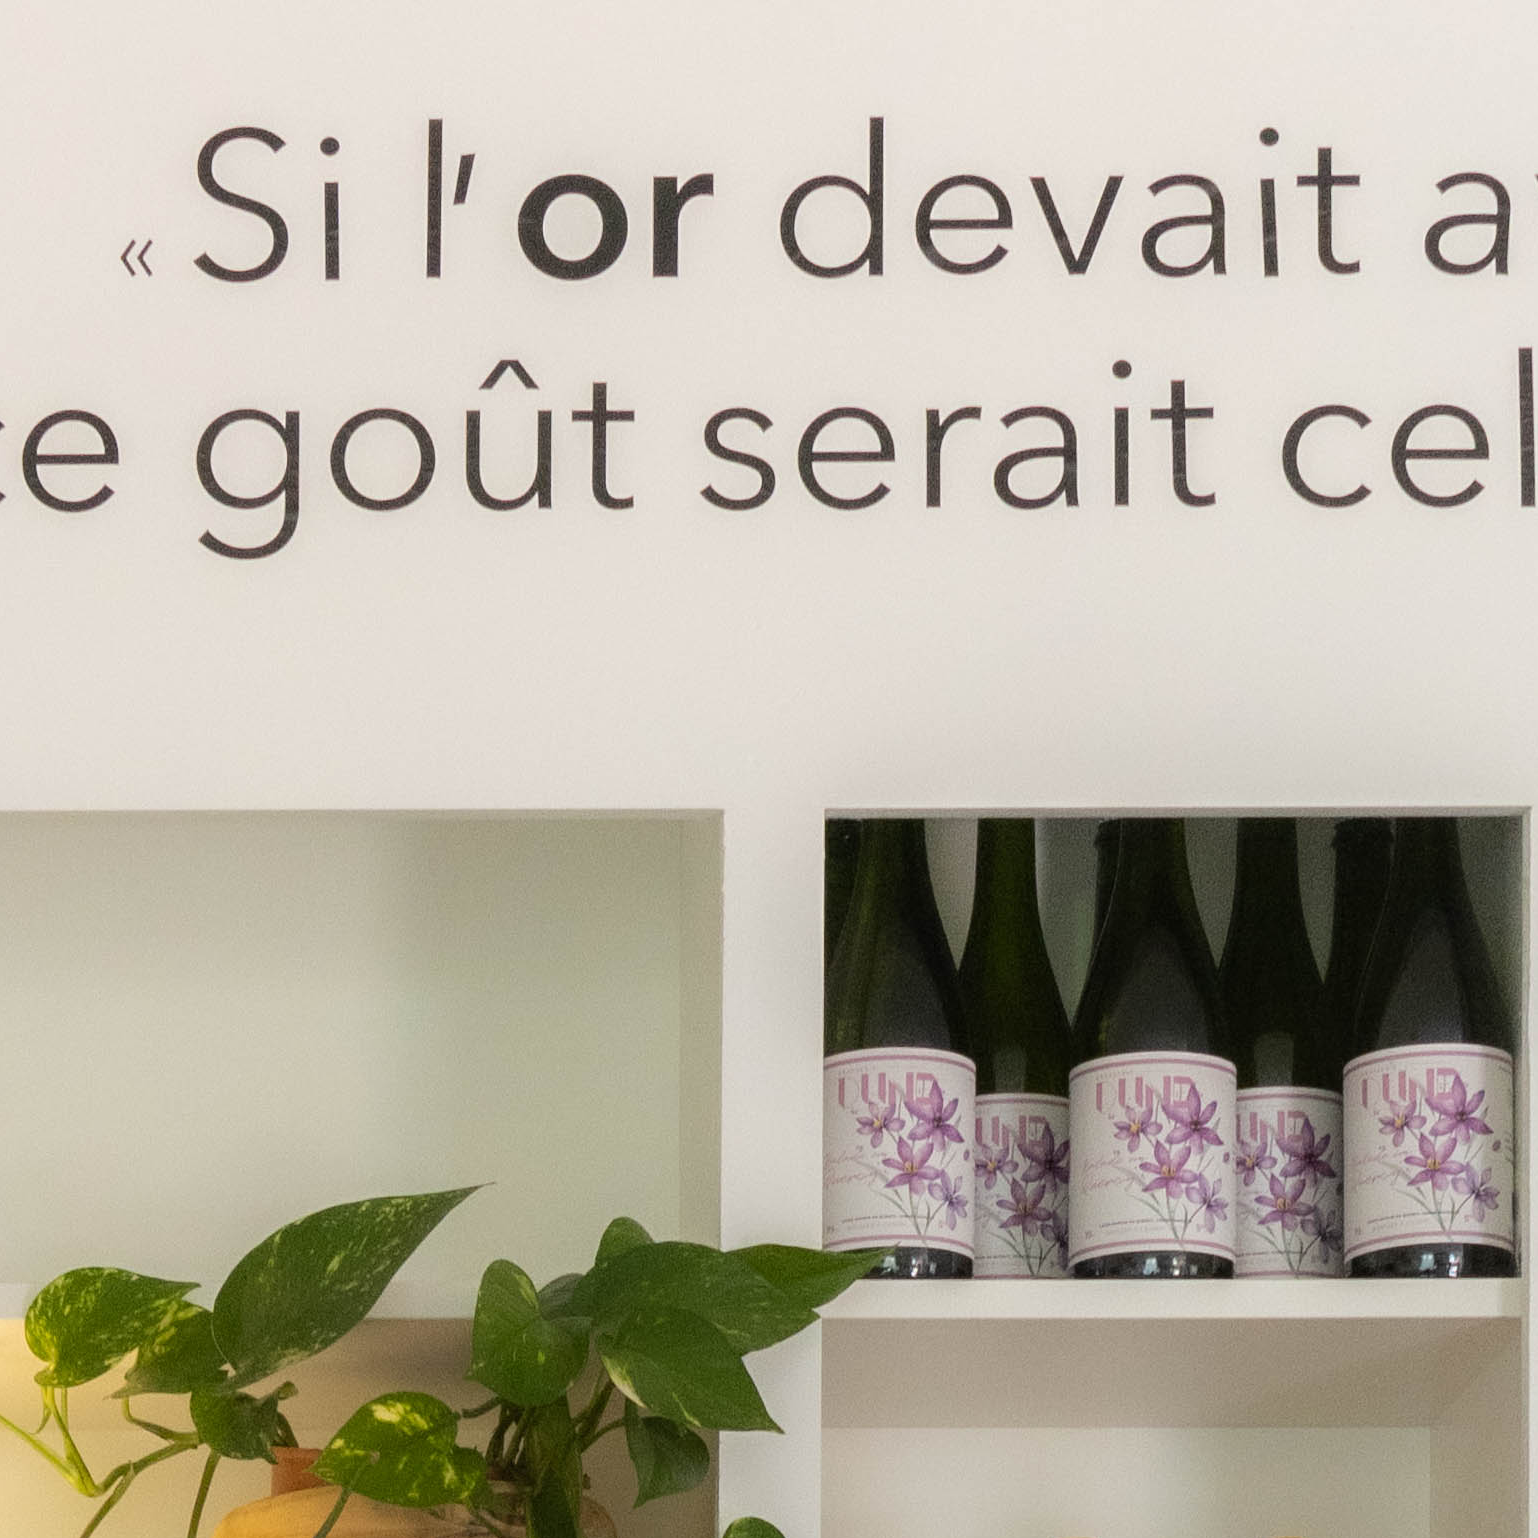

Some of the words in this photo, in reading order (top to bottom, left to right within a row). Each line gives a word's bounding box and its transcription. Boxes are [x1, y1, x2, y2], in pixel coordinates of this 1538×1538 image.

[195, 128, 340, 283] Si
[781, 116, 1362, 280] devait
[197, 360, 637, 561] goût
[701, 360, 1218, 513] serait
